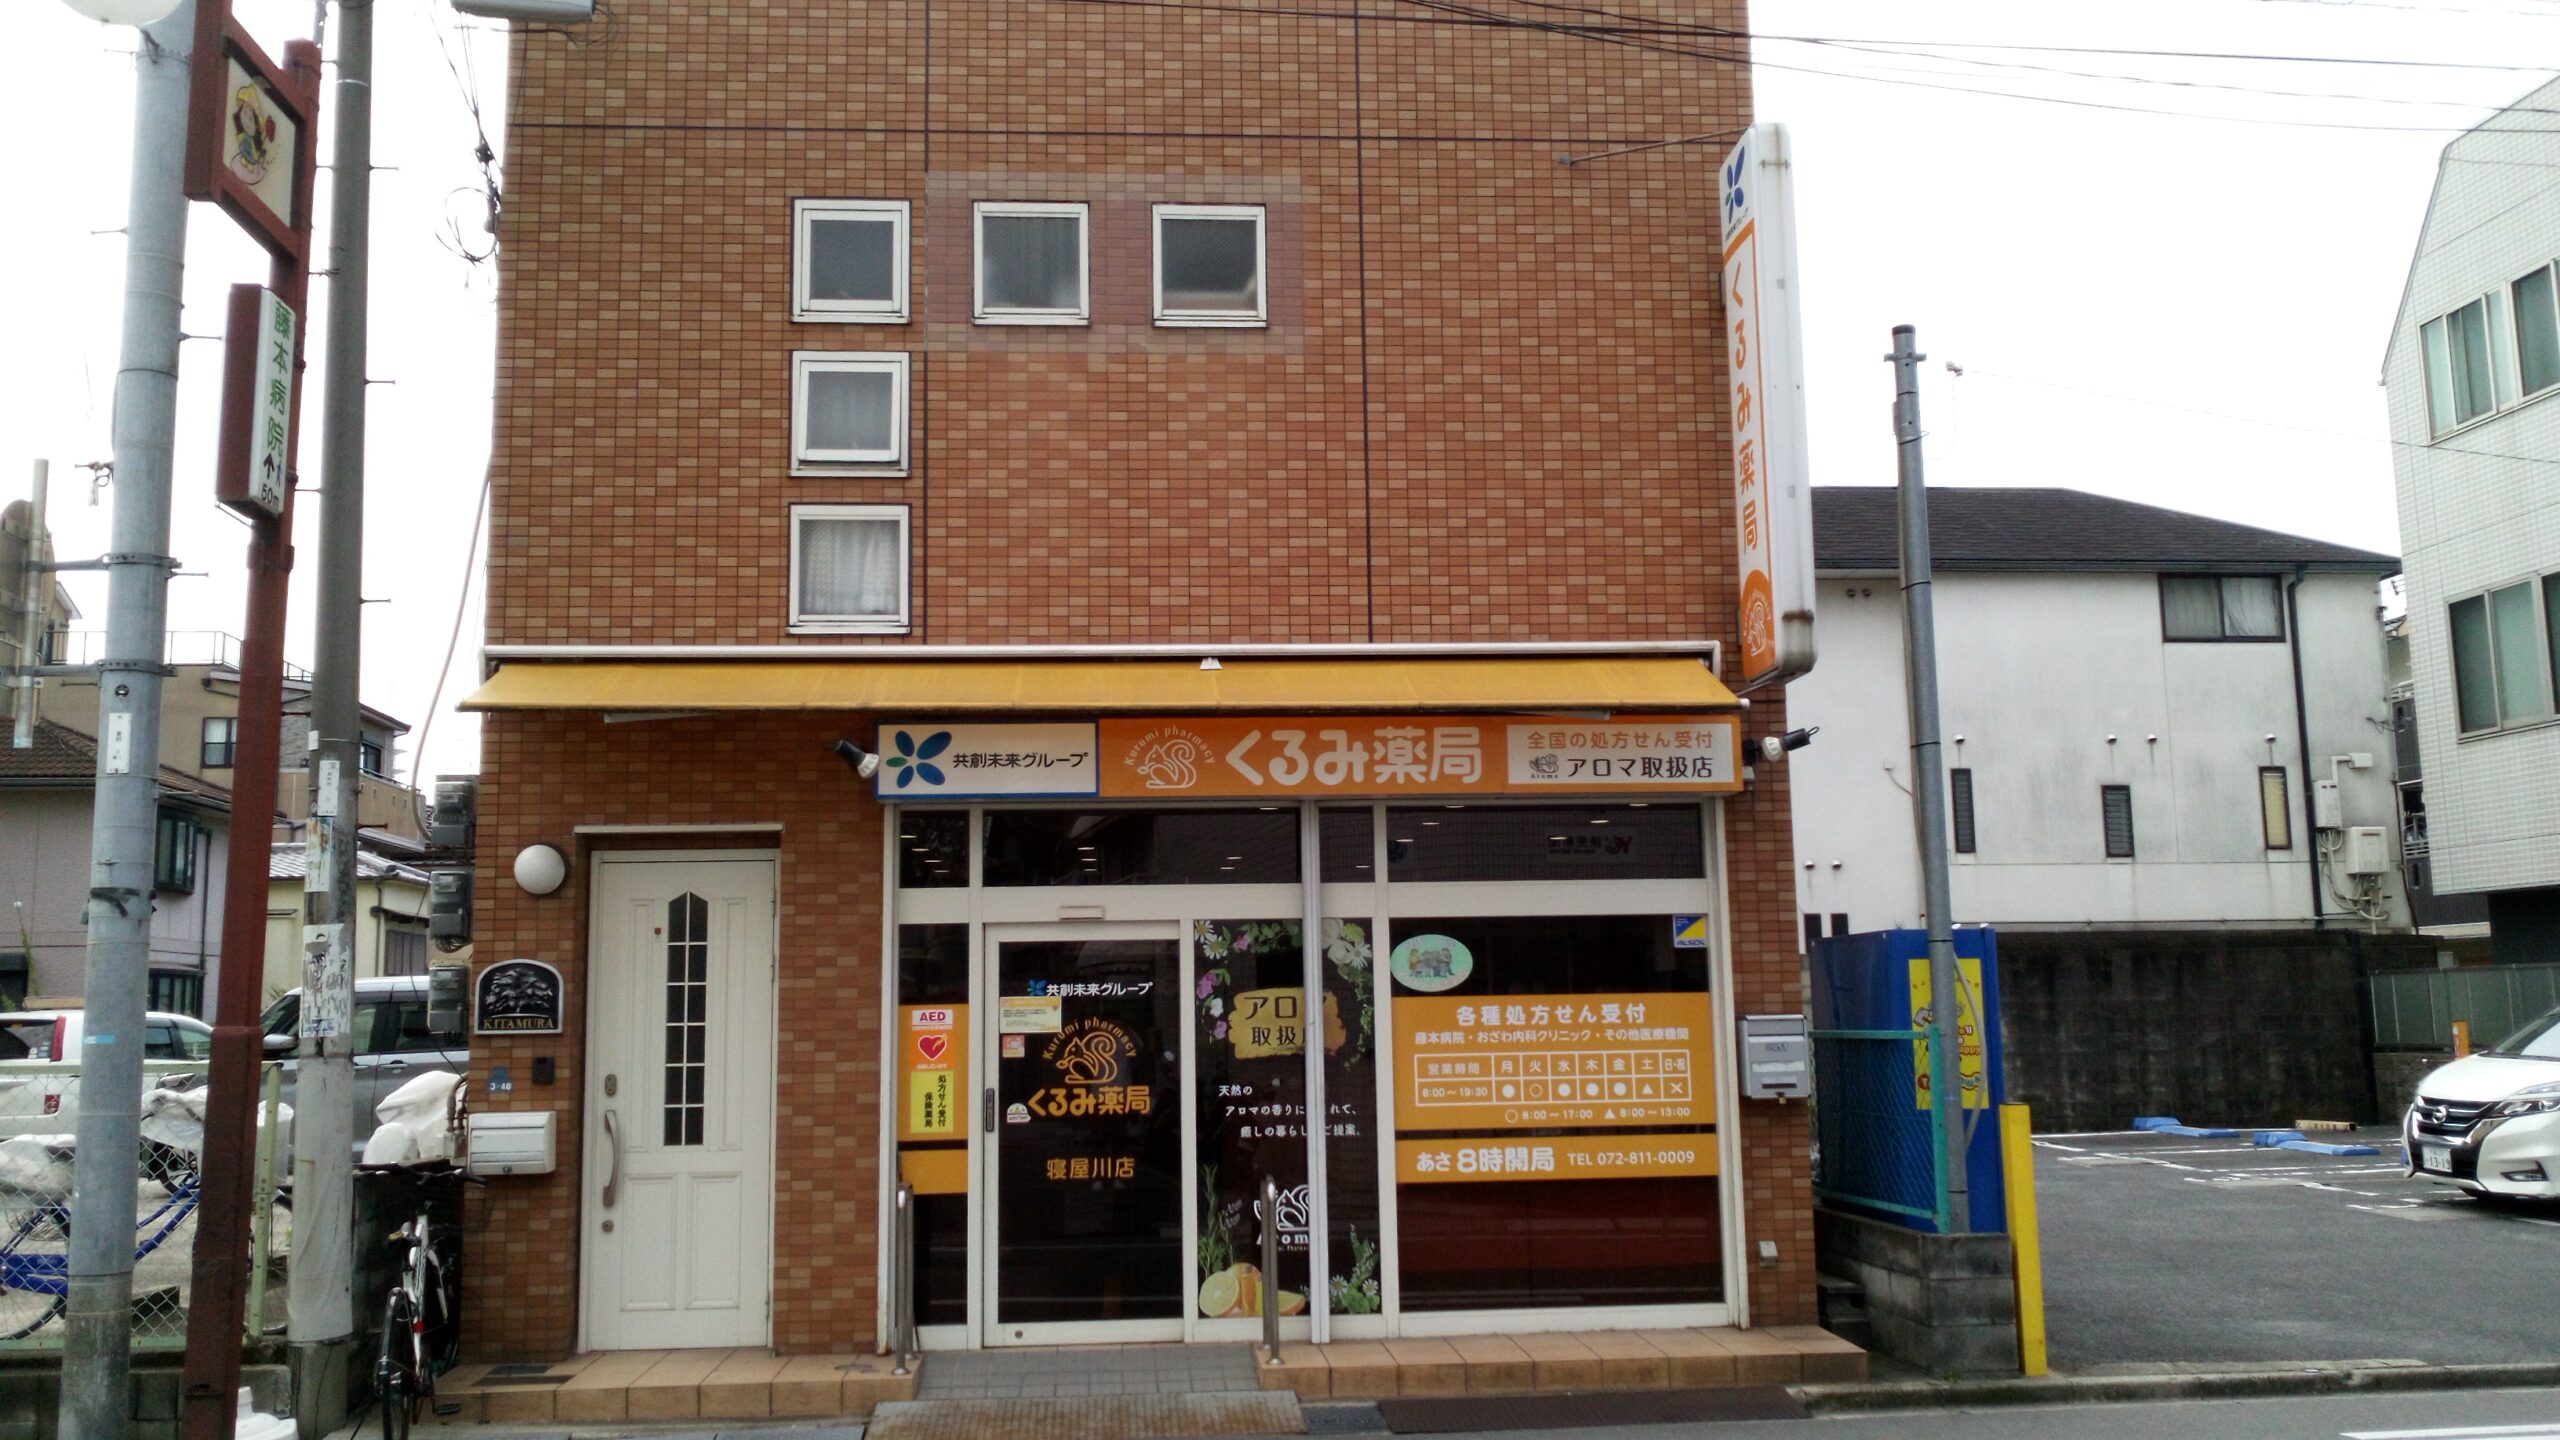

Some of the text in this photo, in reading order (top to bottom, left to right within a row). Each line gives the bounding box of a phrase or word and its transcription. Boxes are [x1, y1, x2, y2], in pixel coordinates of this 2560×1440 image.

[267, 301, 291, 459] 藤本病院
[1731, 260, 1758, 554] くるみ薬局
[1123, 724, 1217, 766] Kurumi pharmacy
[1527, 731, 1714, 750] 全国の処方せん受付
[1225, 726, 1482, 786] くるみ薬局
[1567, 756, 1713, 778] アロマ取扱店
[919, 1011, 946, 1022] AED
[1244, 996, 1310, 1021] アロ
[1456, 1003, 1646, 1026] 各種処方せん受付
[483, 1017, 554, 1030] KITAMURA
[1042, 1016, 1137, 1060] Kurumi pharmacy
[1251, 1025, 1306, 1046] 取扱
[1428, 1062, 1480, 1075] 営業時間
[1501, 1060, 1513, 1073] 月
[1529, 1059, 1541, 1073] 火
[1558, 1059, 1570, 1072] 水
[1586, 1058, 1598, 1072] 木
[1613, 1058, 1625, 1071] 金
[1642, 1057, 1654, 1070] 土
[938, 1074, 947, 1127] 処方せん受付
[1028, 1085, 1150, 1117] くるみ薬局
[1219, 1084, 1253, 1096] 天然の
[1225, 1103, 1357, 1116] アロマの香りにれて、
[1241, 1123, 1361, 1138] 癒しの暮らしご提案。
[1047, 1156, 1135, 1180] 寝屋川店
[1568, 1153, 1593, 1166] TEL
[1597, 1151, 1696, 1165] 072-811-0009
